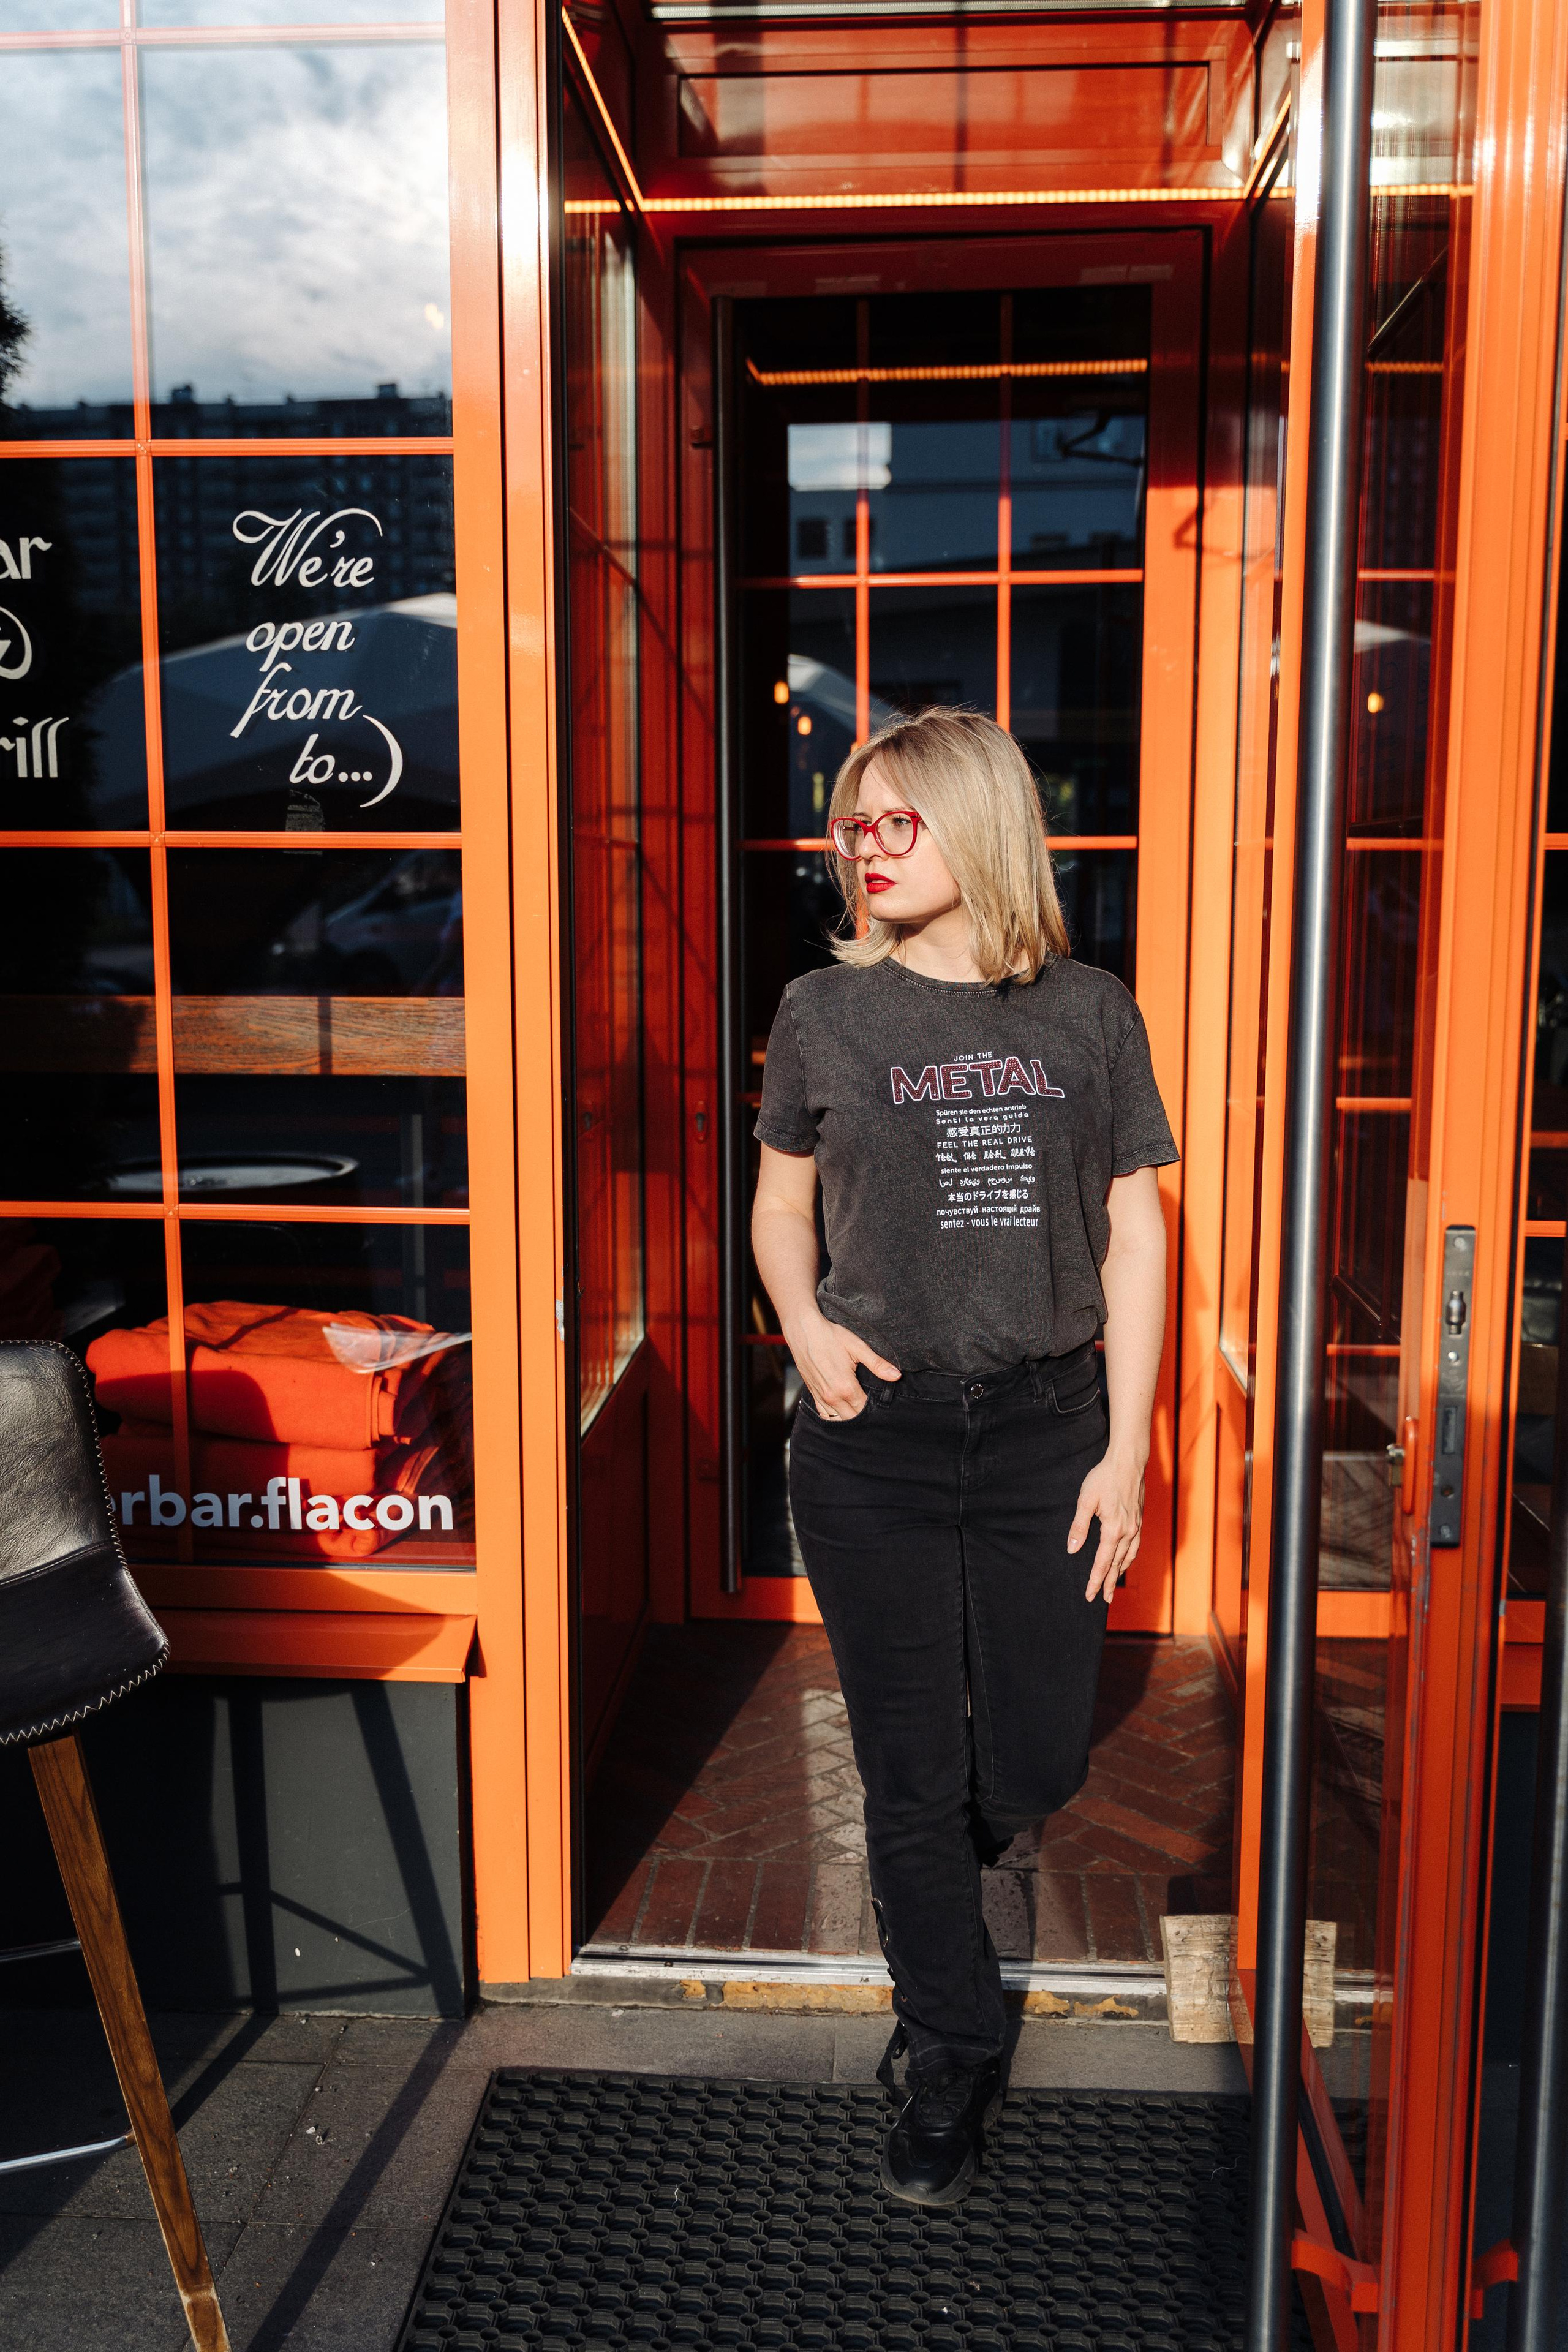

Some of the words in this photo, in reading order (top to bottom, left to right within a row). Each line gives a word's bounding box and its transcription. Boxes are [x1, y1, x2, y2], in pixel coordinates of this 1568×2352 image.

[233, 508, 383, 587] We're
[246, 621, 355, 672] open
[230, 662, 363, 738] from
[891, 1057, 1065, 1104] METAL
[1003, 1112, 1028, 1121] guida
[937, 1206, 978, 1216] почувствуй
[1020, 1204, 1040, 1214] драйв
[941, 1219, 964, 1229] sentez
[971, 1218, 989, 1227] vous
[991, 1215, 997, 1226] le
[1000, 1216, 1011, 1226] vrai
[1014, 1216, 1038, 1227] lecteur
[110, 1474, 453, 1531] rbar.flacon
